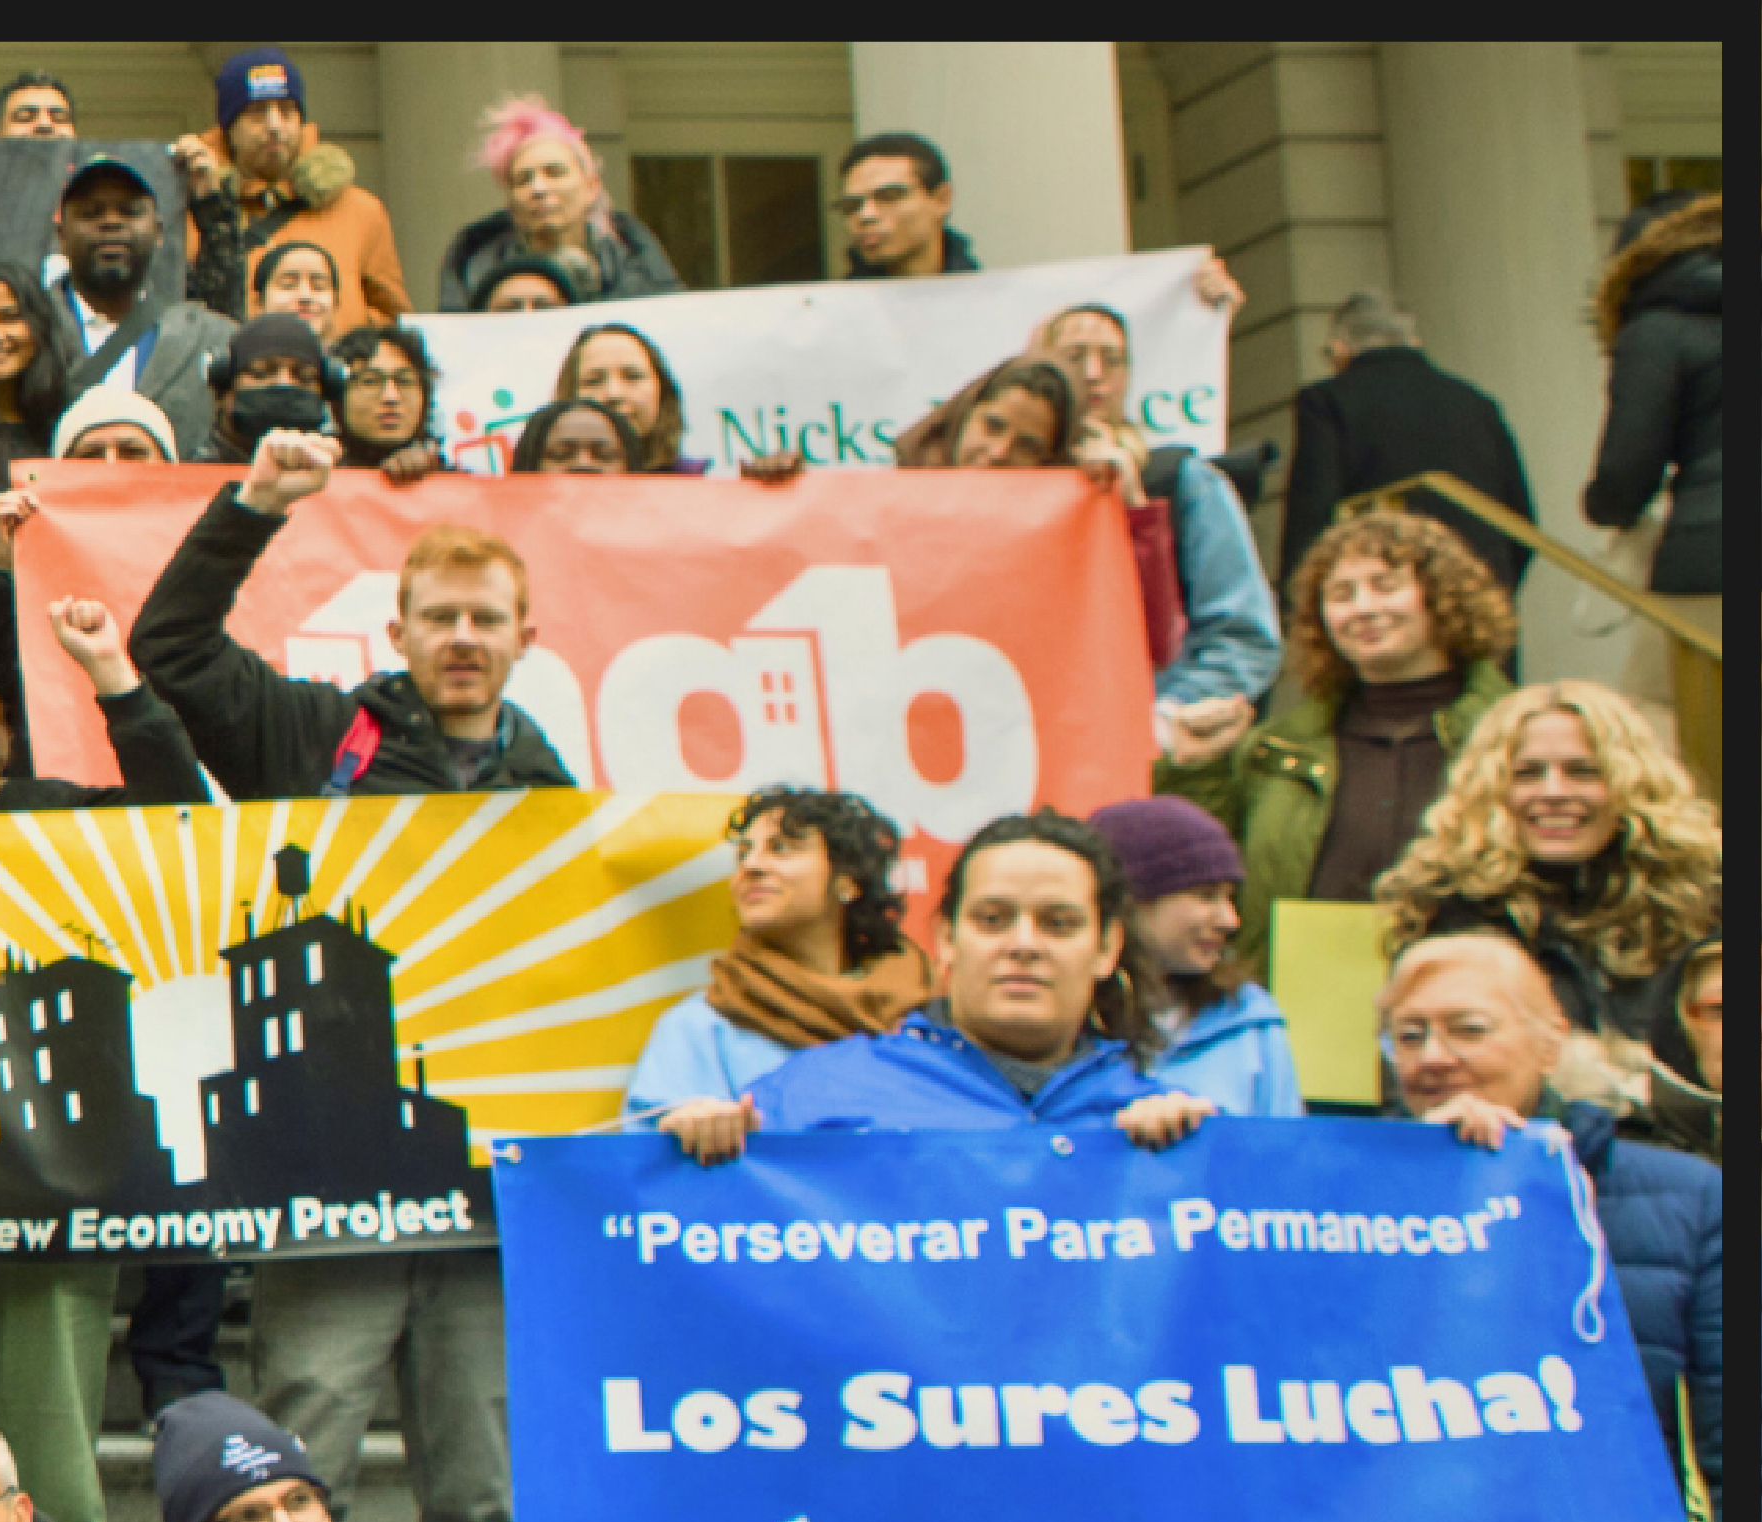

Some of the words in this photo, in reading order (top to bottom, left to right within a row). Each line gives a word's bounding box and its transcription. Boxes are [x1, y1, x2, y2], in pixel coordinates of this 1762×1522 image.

[715, 402, 897, 464] Nicks
[67, 1206, 281, 1257] Economy
[290, 1188, 474, 1244] Project
[1003, 1206, 1155, 1259] Para
[601, 1376, 806, 1453] Los
[841, 1371, 1202, 1450] Sures
[1223, 1354, 1583, 1445] Lucha!
